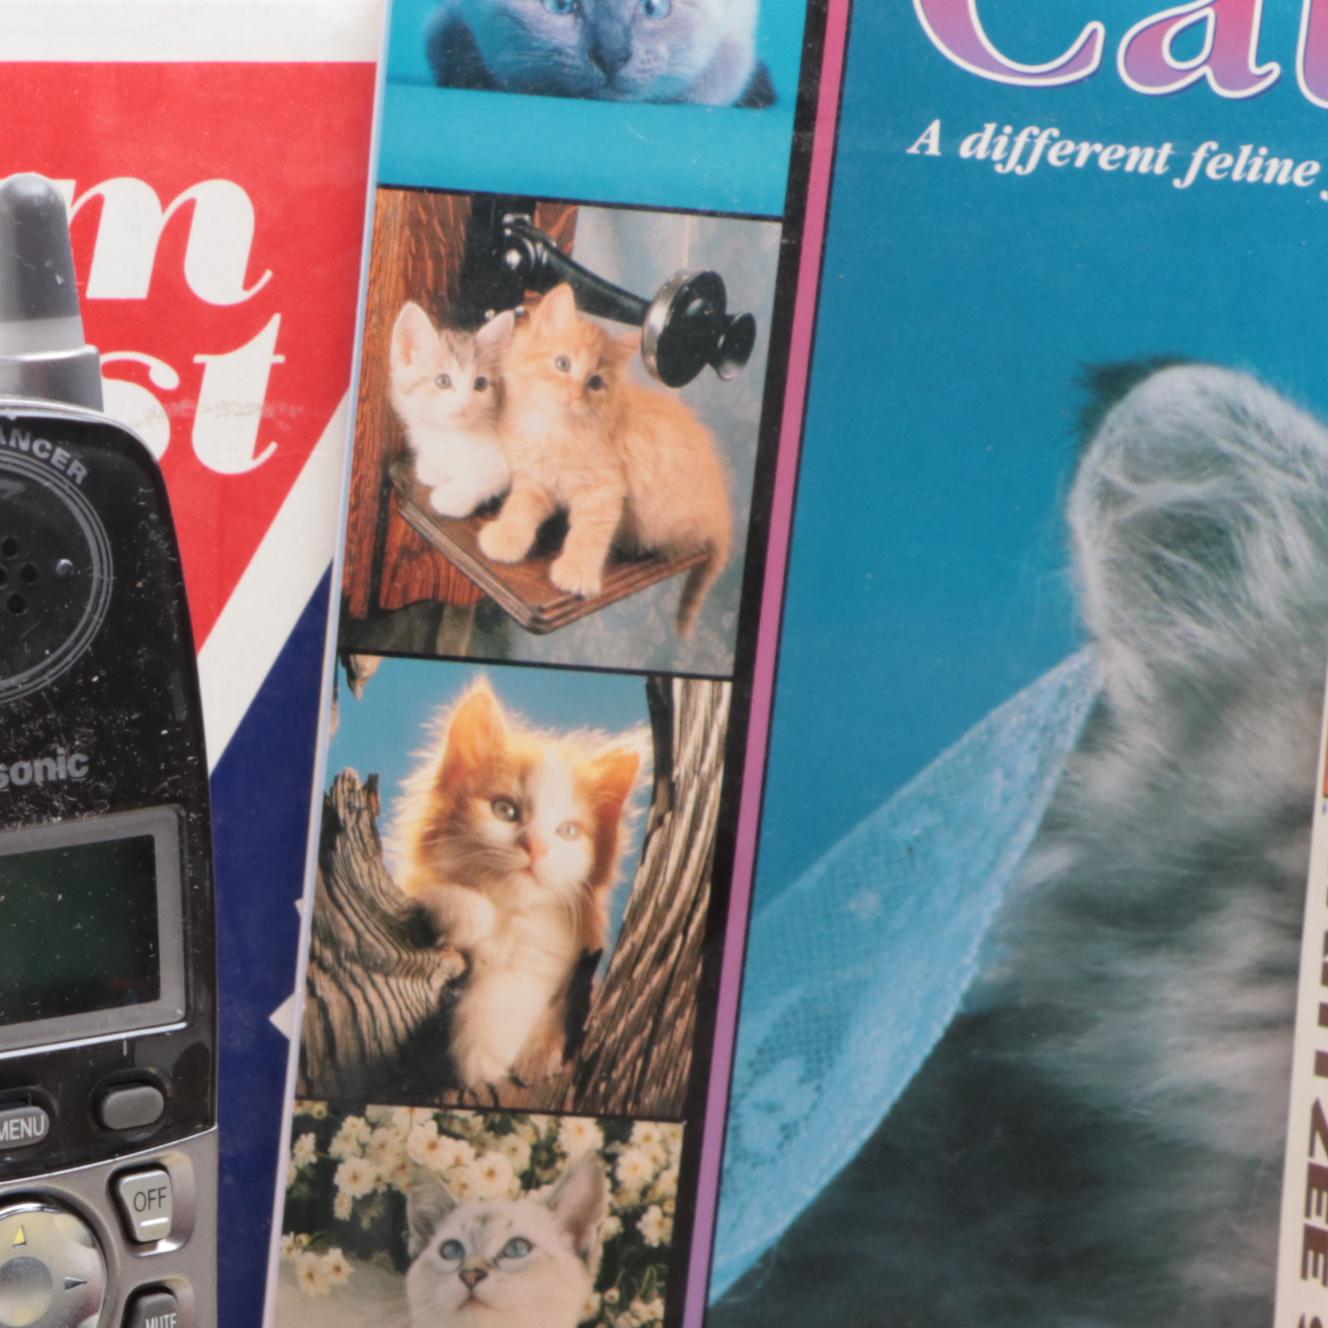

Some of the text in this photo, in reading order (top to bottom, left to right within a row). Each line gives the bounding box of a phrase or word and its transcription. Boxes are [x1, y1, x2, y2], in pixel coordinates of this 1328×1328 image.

[907, 119, 1321, 190] A different feline
[133, 1187, 168, 1213] OFF
